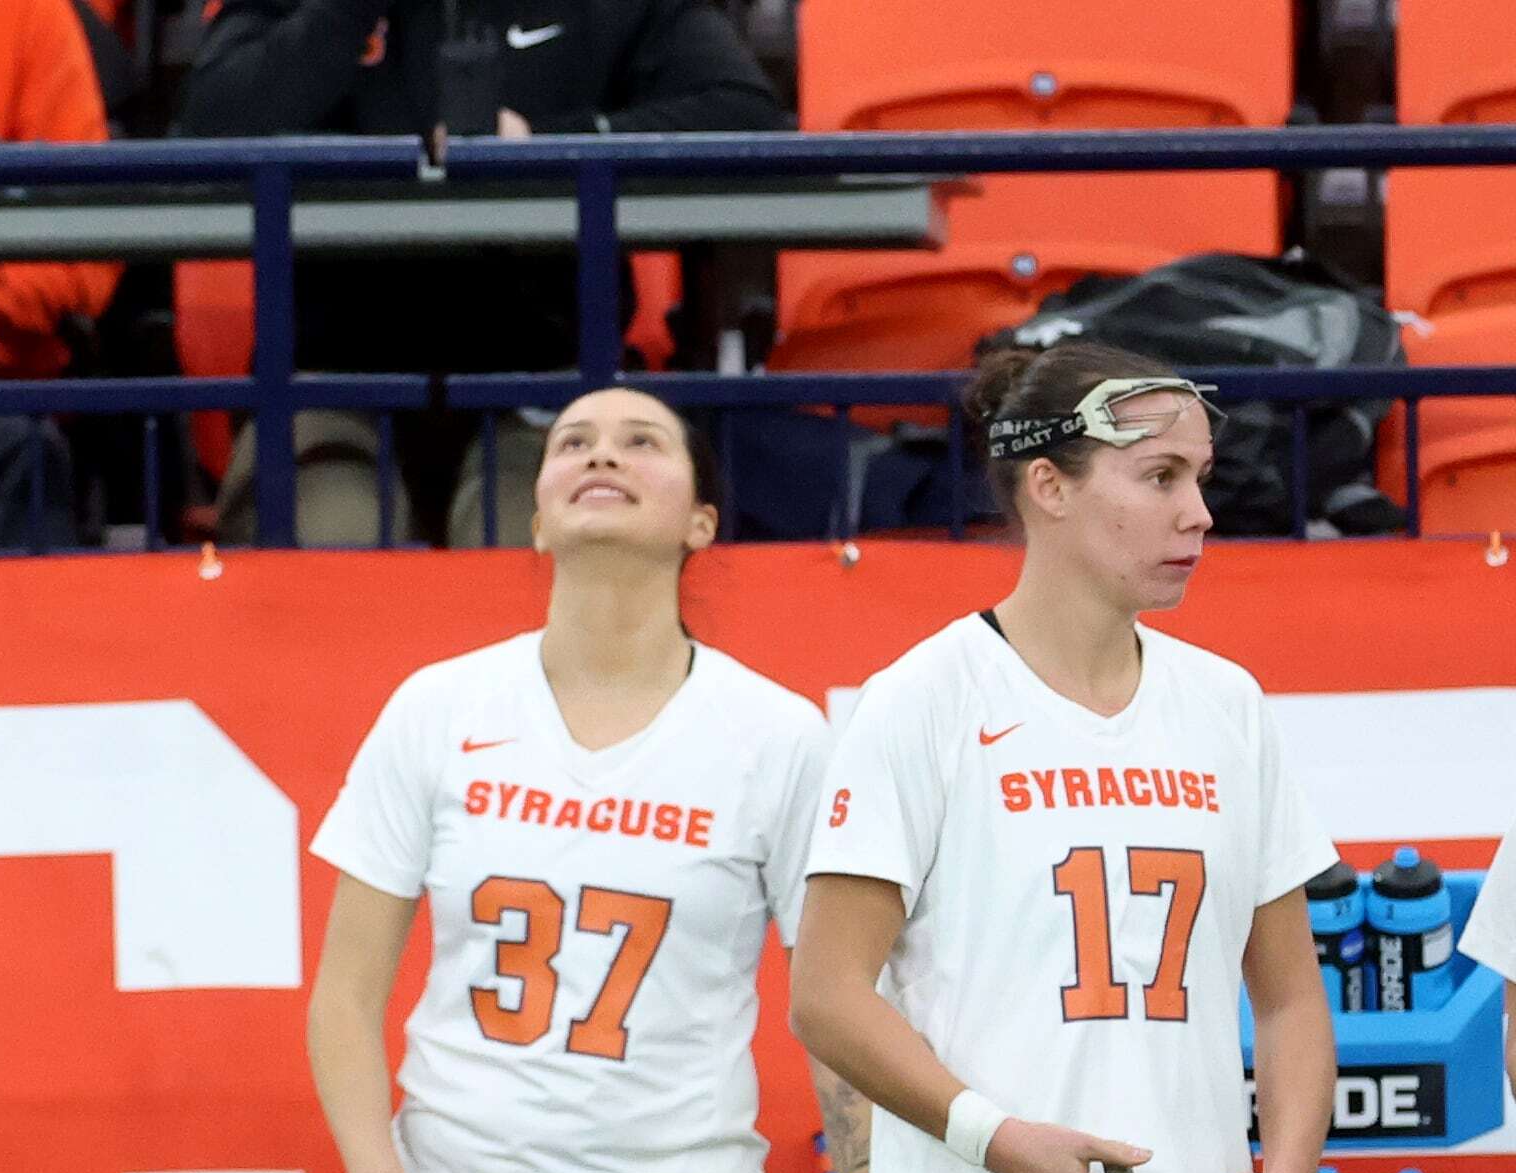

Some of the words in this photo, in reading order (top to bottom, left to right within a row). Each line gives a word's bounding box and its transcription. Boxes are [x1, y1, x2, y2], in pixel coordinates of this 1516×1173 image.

[1011, 428, 1053, 452] GAIT
[463, 779, 715, 848] SYRACUSE
[829, 788, 851, 828] S
[1000, 768, 1219, 813] SYRACUSE
[1052, 846, 1207, 1023] 17
[469, 874, 674, 1062] 37
